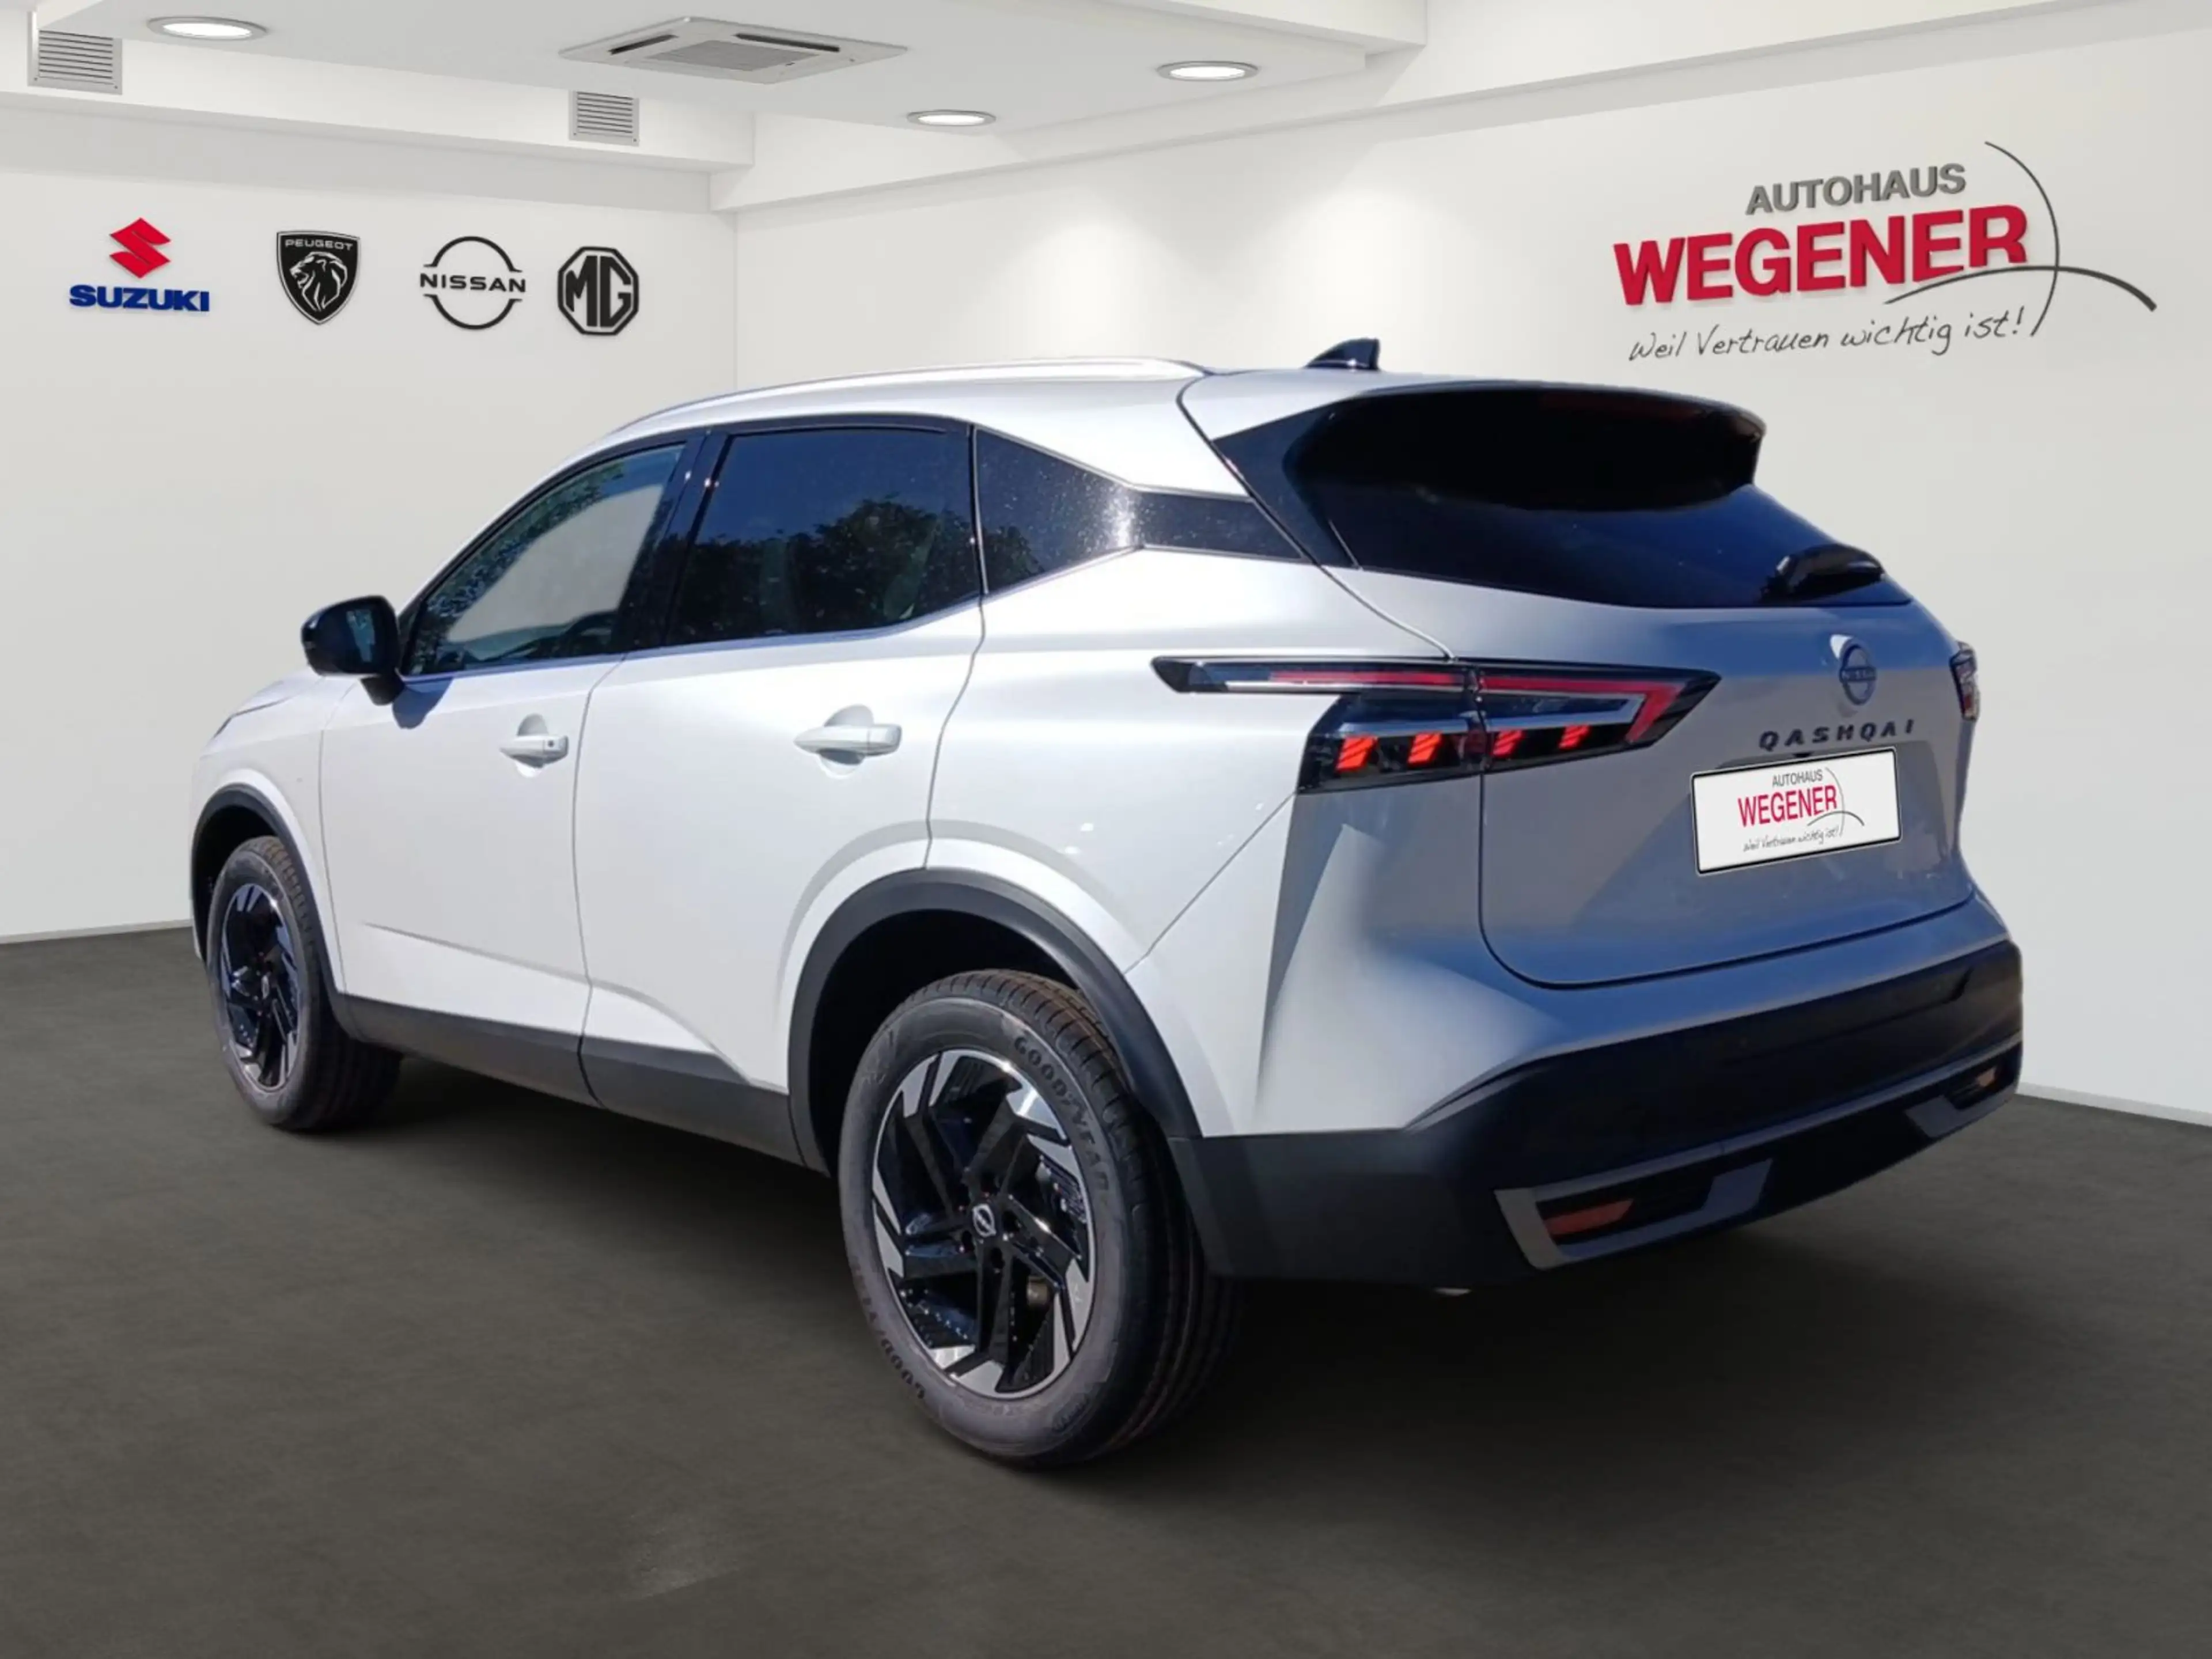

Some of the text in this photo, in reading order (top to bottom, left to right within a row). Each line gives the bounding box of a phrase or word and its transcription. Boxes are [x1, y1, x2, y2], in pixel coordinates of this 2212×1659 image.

[1745, 162, 1967, 215] AUTOHAUS
[285, 238, 353, 251] PEUGEOT
[1613, 204, 2028, 305] WEGENER
[69, 285, 210, 312] SUZUKI
[420, 272, 526, 293] NISSAN
[565, 255, 632, 327] MG
[1628, 305, 2025, 361] Weil Vertrauen wichtig ist!
[1759, 719, 1915, 751] QASHQAI
[1772, 768, 1823, 787] AUTOHAUS
[1737, 784, 1838, 828] WEGENER
